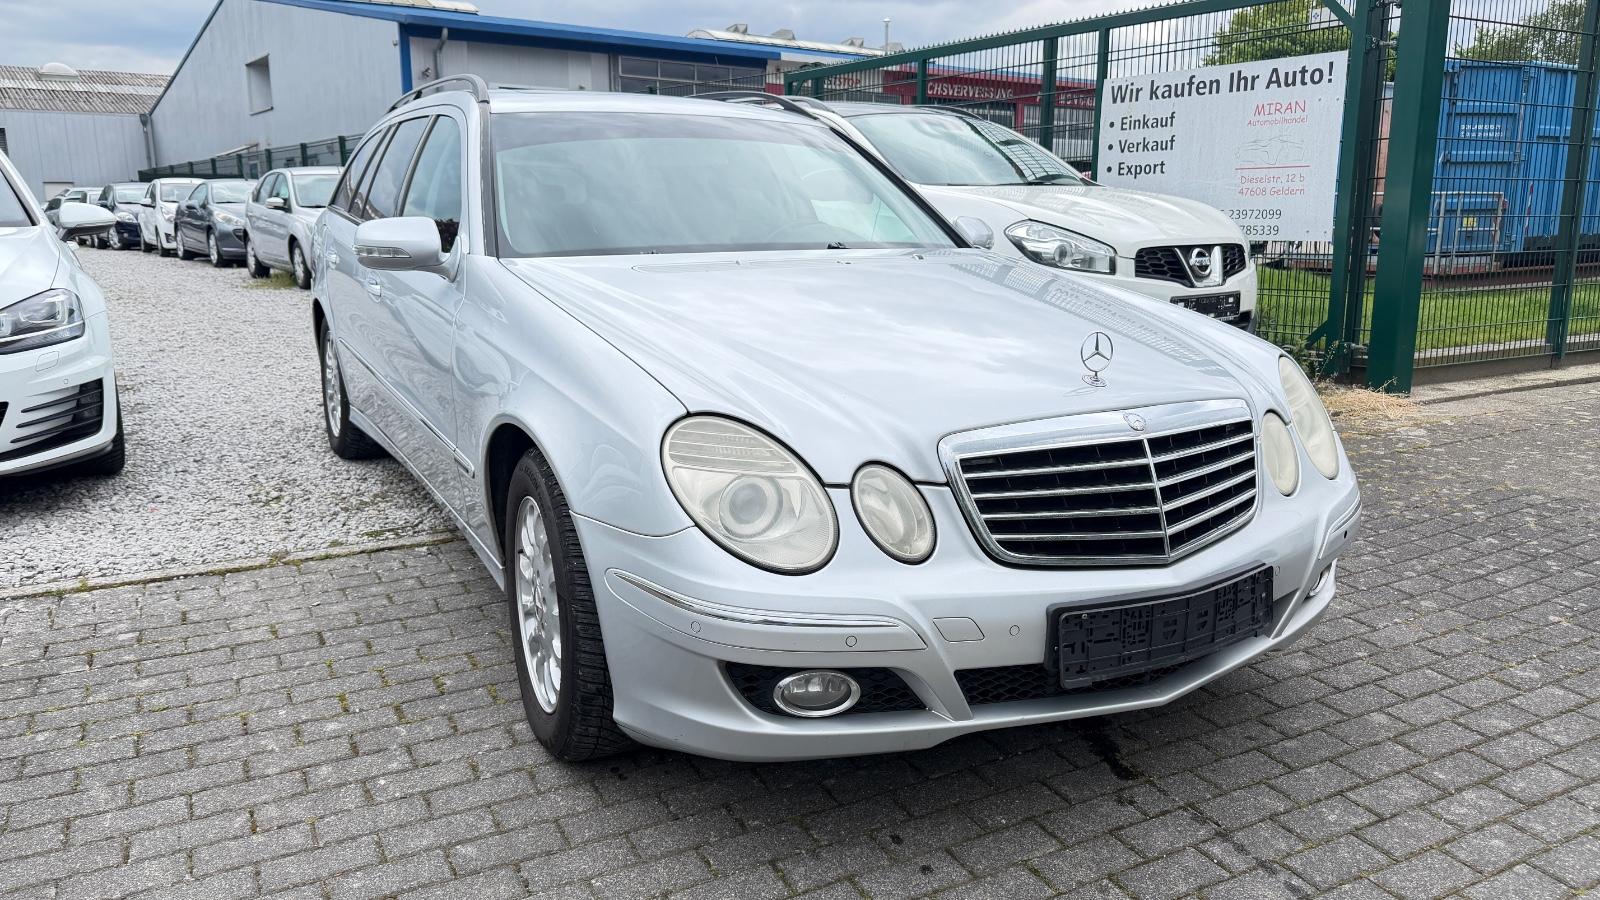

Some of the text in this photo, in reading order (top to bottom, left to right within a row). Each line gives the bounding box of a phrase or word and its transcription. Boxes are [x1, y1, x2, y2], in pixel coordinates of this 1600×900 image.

[1110, 84, 1143, 105] Wir
[1149, 74, 1221, 101] kaufen
[1228, 69, 1260, 94] Ihr
[1265, 61, 1335, 90] Auto!
[1253, 99, 1306, 117] MIRAN
[1120, 112, 1176, 131] Einkauf
[1247, 115, 1309, 127] Automobilhandel
[1118, 135, 1176, 154] Verkauf
[1117, 160, 1166, 179] Export
[1286, 173, 1297, 183] 12
[1299, 173, 1305, 182] b
[1238, 186, 1305, 197] 47608 Geldern
[1228, 208, 1282, 220] 23972099
